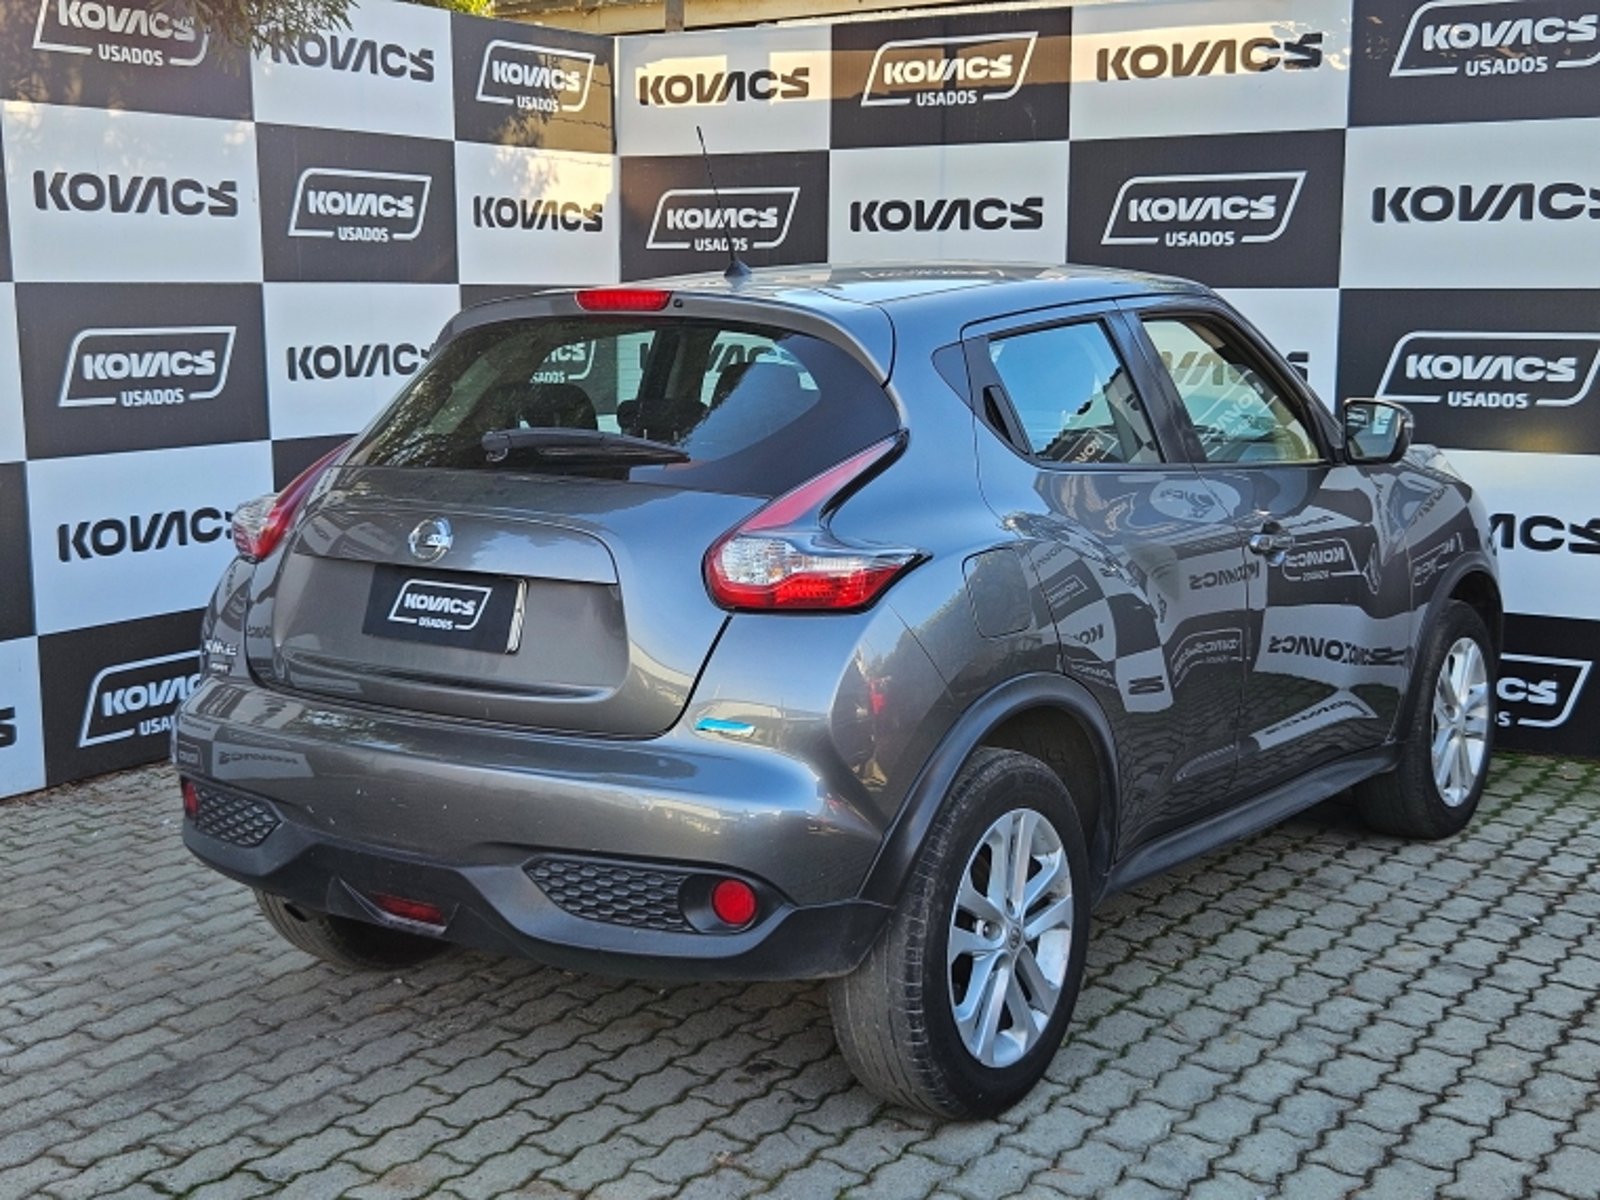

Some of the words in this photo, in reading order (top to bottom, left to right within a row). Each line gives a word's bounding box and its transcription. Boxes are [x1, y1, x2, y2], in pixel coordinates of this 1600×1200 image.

[58, 0, 195, 42] KOVACS
[1422, 14, 1599, 51] KOVACS
[98, 44, 164, 66] USADOS
[883, 54, 1013, 85] KOVACS
[1097, 33, 1323, 81] KOVACS
[1465, 57, 1548, 76] USADOS
[492, 61, 580, 92] KOVACS
[639, 67, 810, 106] KOVACS
[516, 96, 559, 113] USADOS
[916, 90, 977, 106] USADOS
[33, 170, 238, 217] KOVACS
[308, 190, 414, 218] KOVACS
[1372, 183, 1600, 223] KOVAC
[473, 195, 603, 232] KOVACS
[667, 207, 778, 230] KOVACS
[850, 197, 1043, 232] KOVACS
[1128, 195, 1277, 222] KOVACS
[338, 227, 388, 242] USADOS
[1165, 231, 1235, 247] USADOS
[83, 350, 215, 380] KOVACS
[287, 343, 430, 381] KOVAC
[1405, 354, 1578, 382] KOVACS
[121, 388, 184, 407] USADOS
[1448, 391, 1529, 408] USADOS
[58, 507, 232, 562] KOVAC
[404, 593, 476, 615] KOVACS
